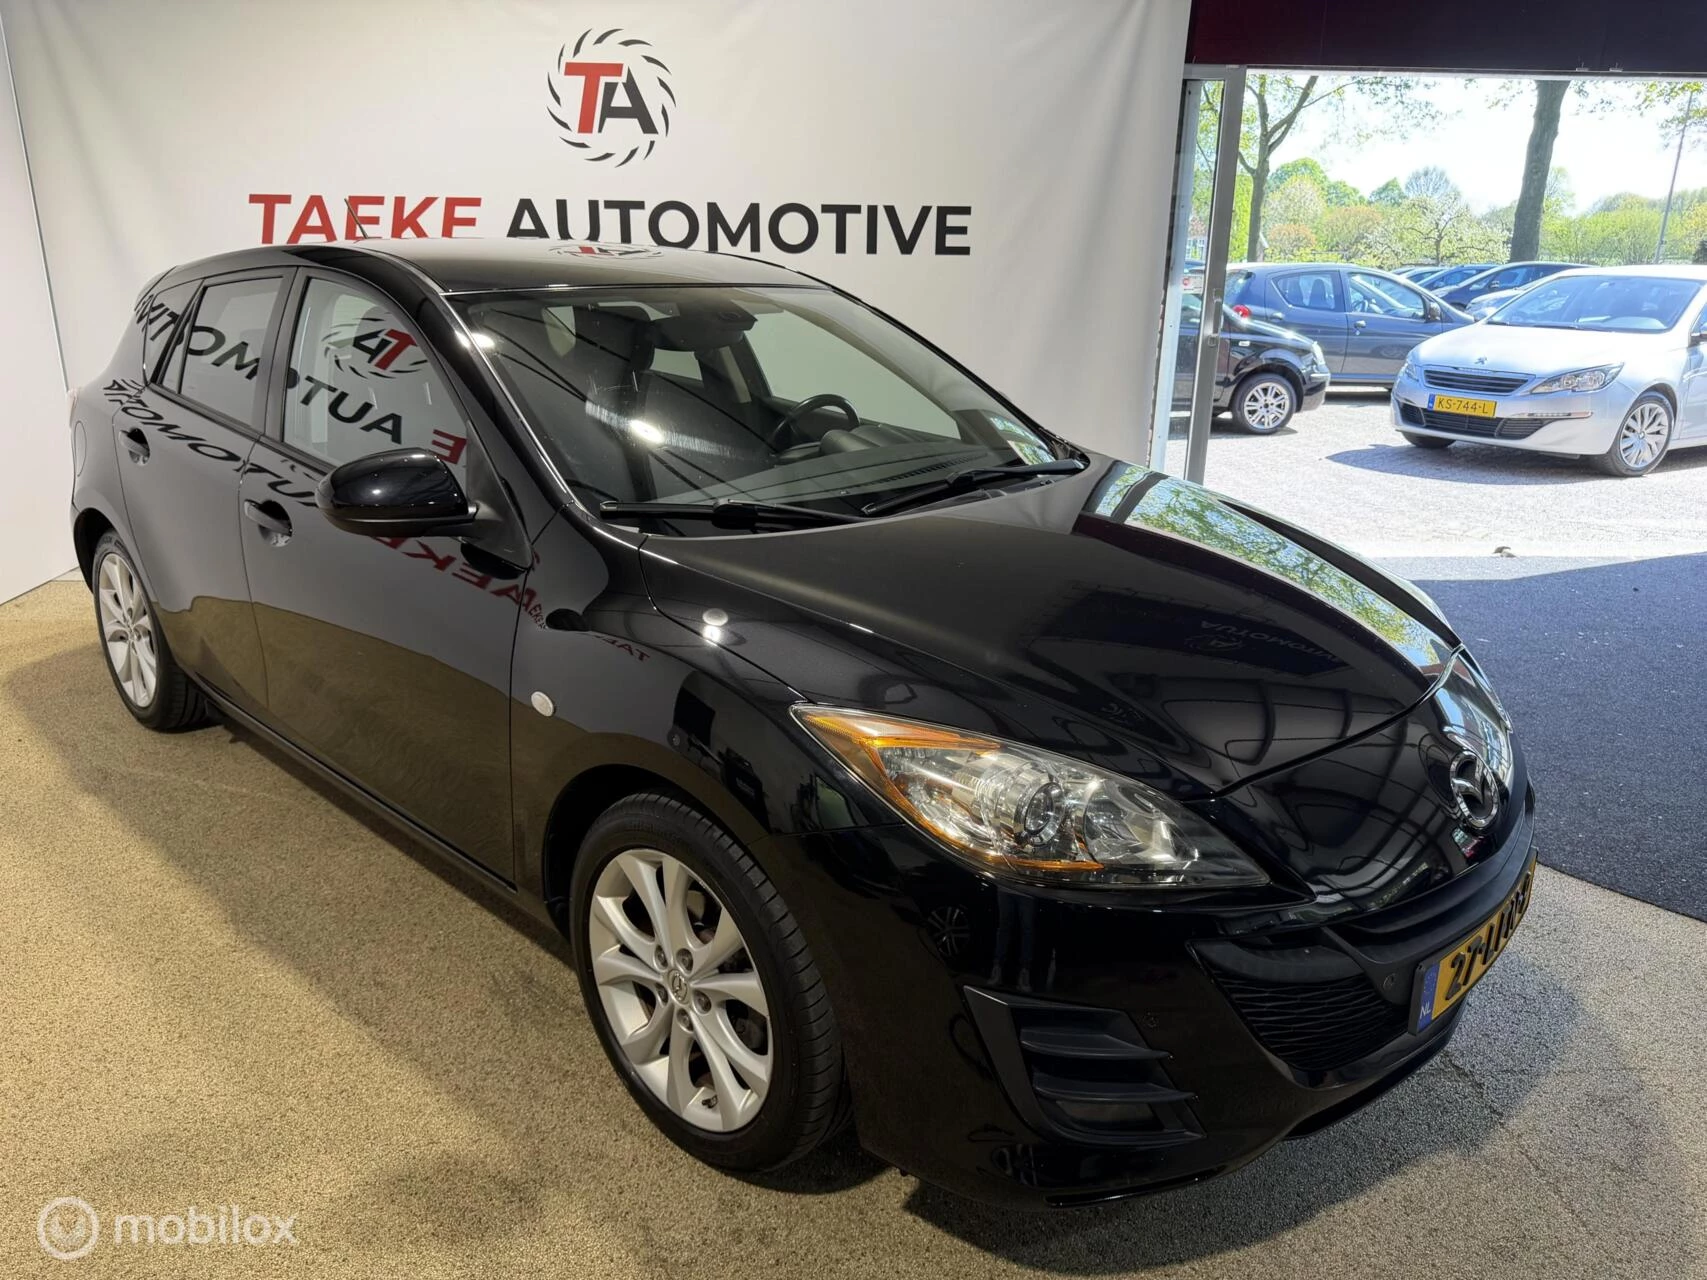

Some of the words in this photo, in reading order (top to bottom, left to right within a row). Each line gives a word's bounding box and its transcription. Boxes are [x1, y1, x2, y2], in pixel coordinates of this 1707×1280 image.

[564, 62, 659, 135] TA
[507, 199, 972, 256] AUTOMOTIVE
[1437, 397, 1489, 414] KS-744-L
[1419, 1003, 1432, 1020] NL
